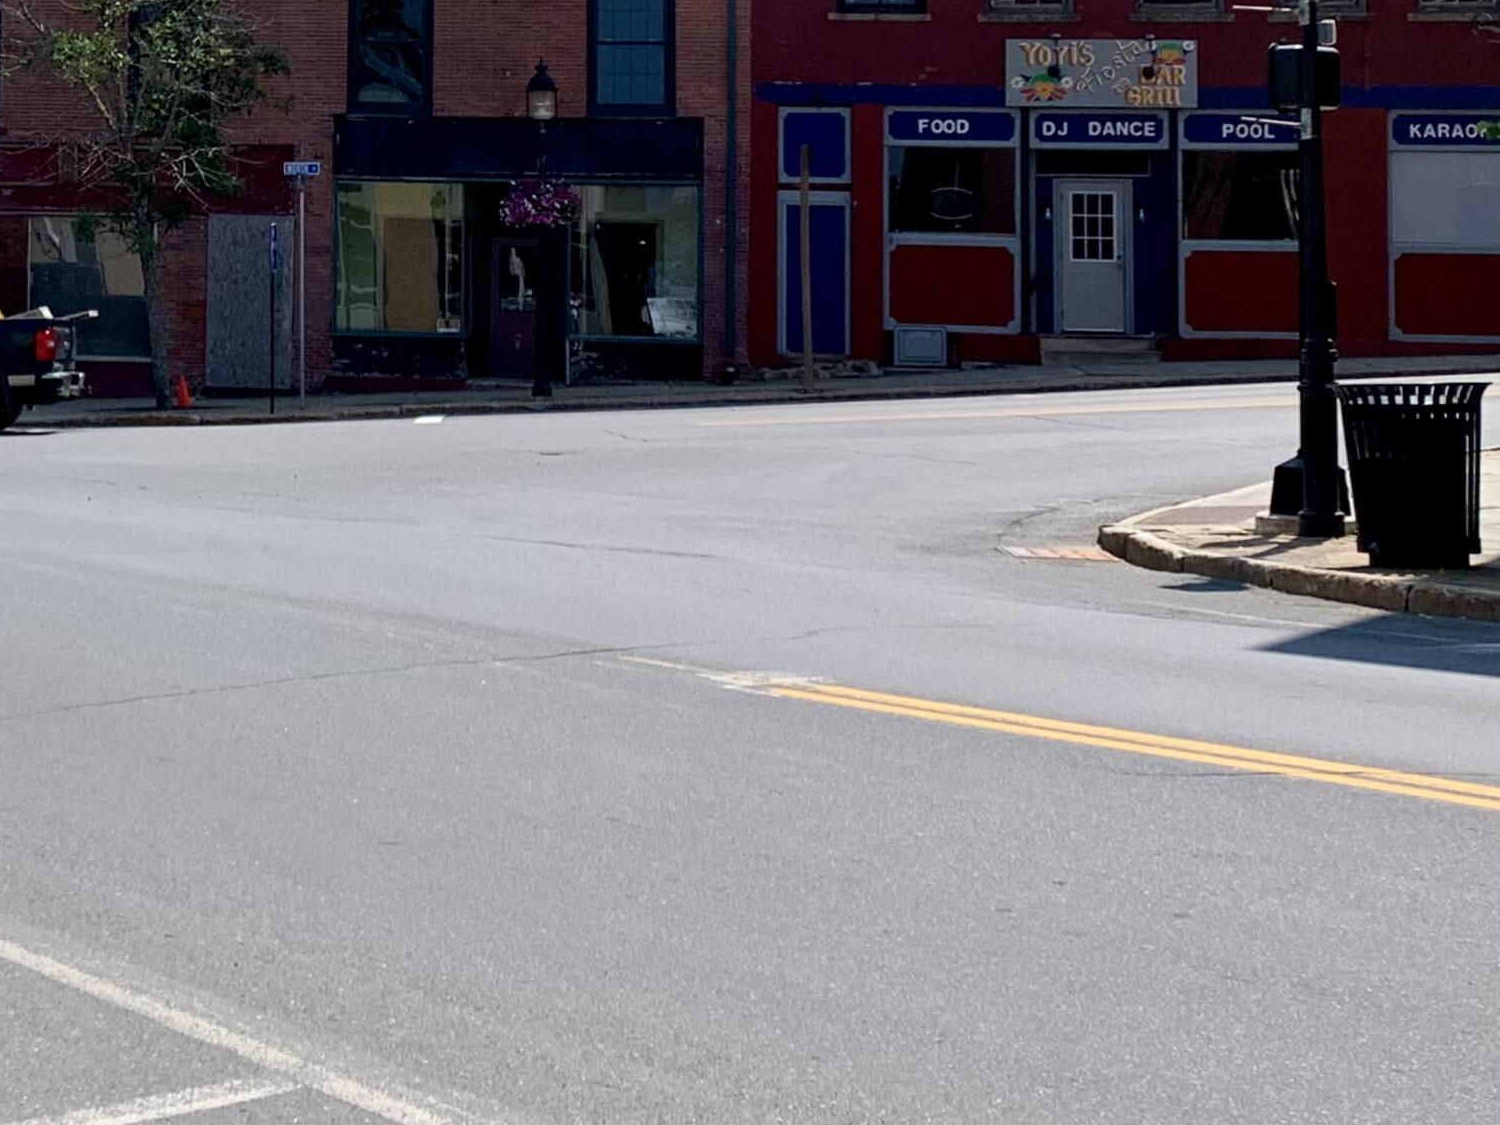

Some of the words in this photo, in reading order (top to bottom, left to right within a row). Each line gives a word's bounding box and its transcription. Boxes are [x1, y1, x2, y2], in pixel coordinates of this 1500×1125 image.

[917, 118, 970, 134] FOOD
[1041, 120, 1069, 137] DJ
[1088, 120, 1157, 138] DANCE
[1221, 122, 1276, 139] POOL
[1408, 123, 1500, 139] KARAO
